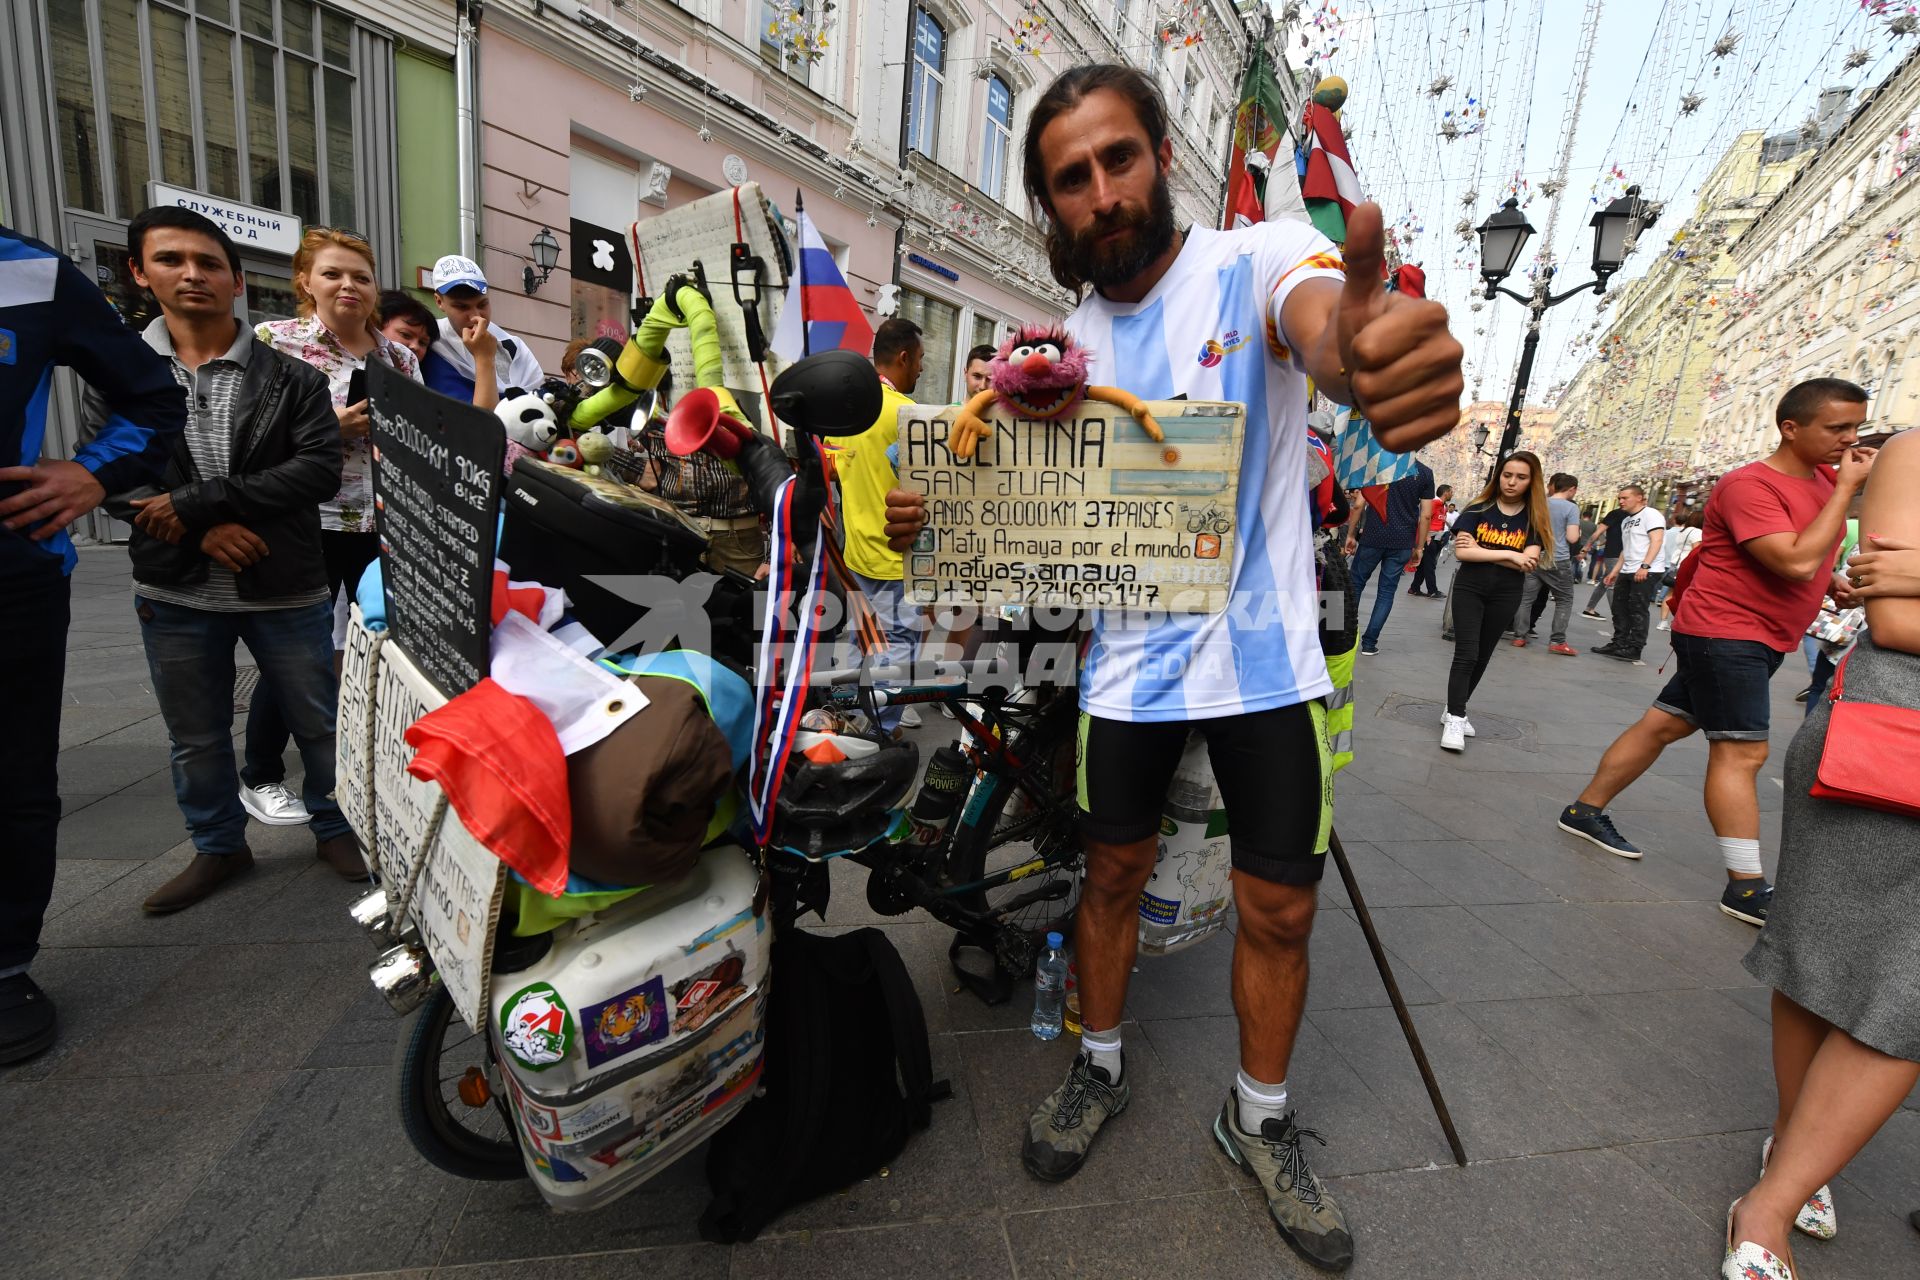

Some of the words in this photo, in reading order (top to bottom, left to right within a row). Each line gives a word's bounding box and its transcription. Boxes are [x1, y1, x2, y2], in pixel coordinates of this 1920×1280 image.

[177, 198, 281, 231] СЛУЖЕБНЫЙ
[219, 221, 258, 240] ХОД
[907, 418, 1106, 468] ARENTINA
[454, 482, 487, 511] BIKE
[909, 470, 976, 496] SAN
[997, 470, 1086, 497] JUAN
[436, 503, 478, 544] STAMPED
[938, 527, 987, 557] Maty
[993, 528, 1062, 558] Amaya
[1071, 540, 1103, 559] por
[1111, 531, 1128, 557] el
[1135, 532, 1190, 559] mundo
[938, 555, 1137, 585] matyas.amaya
[573, 1112, 621, 1138] Polaroid
